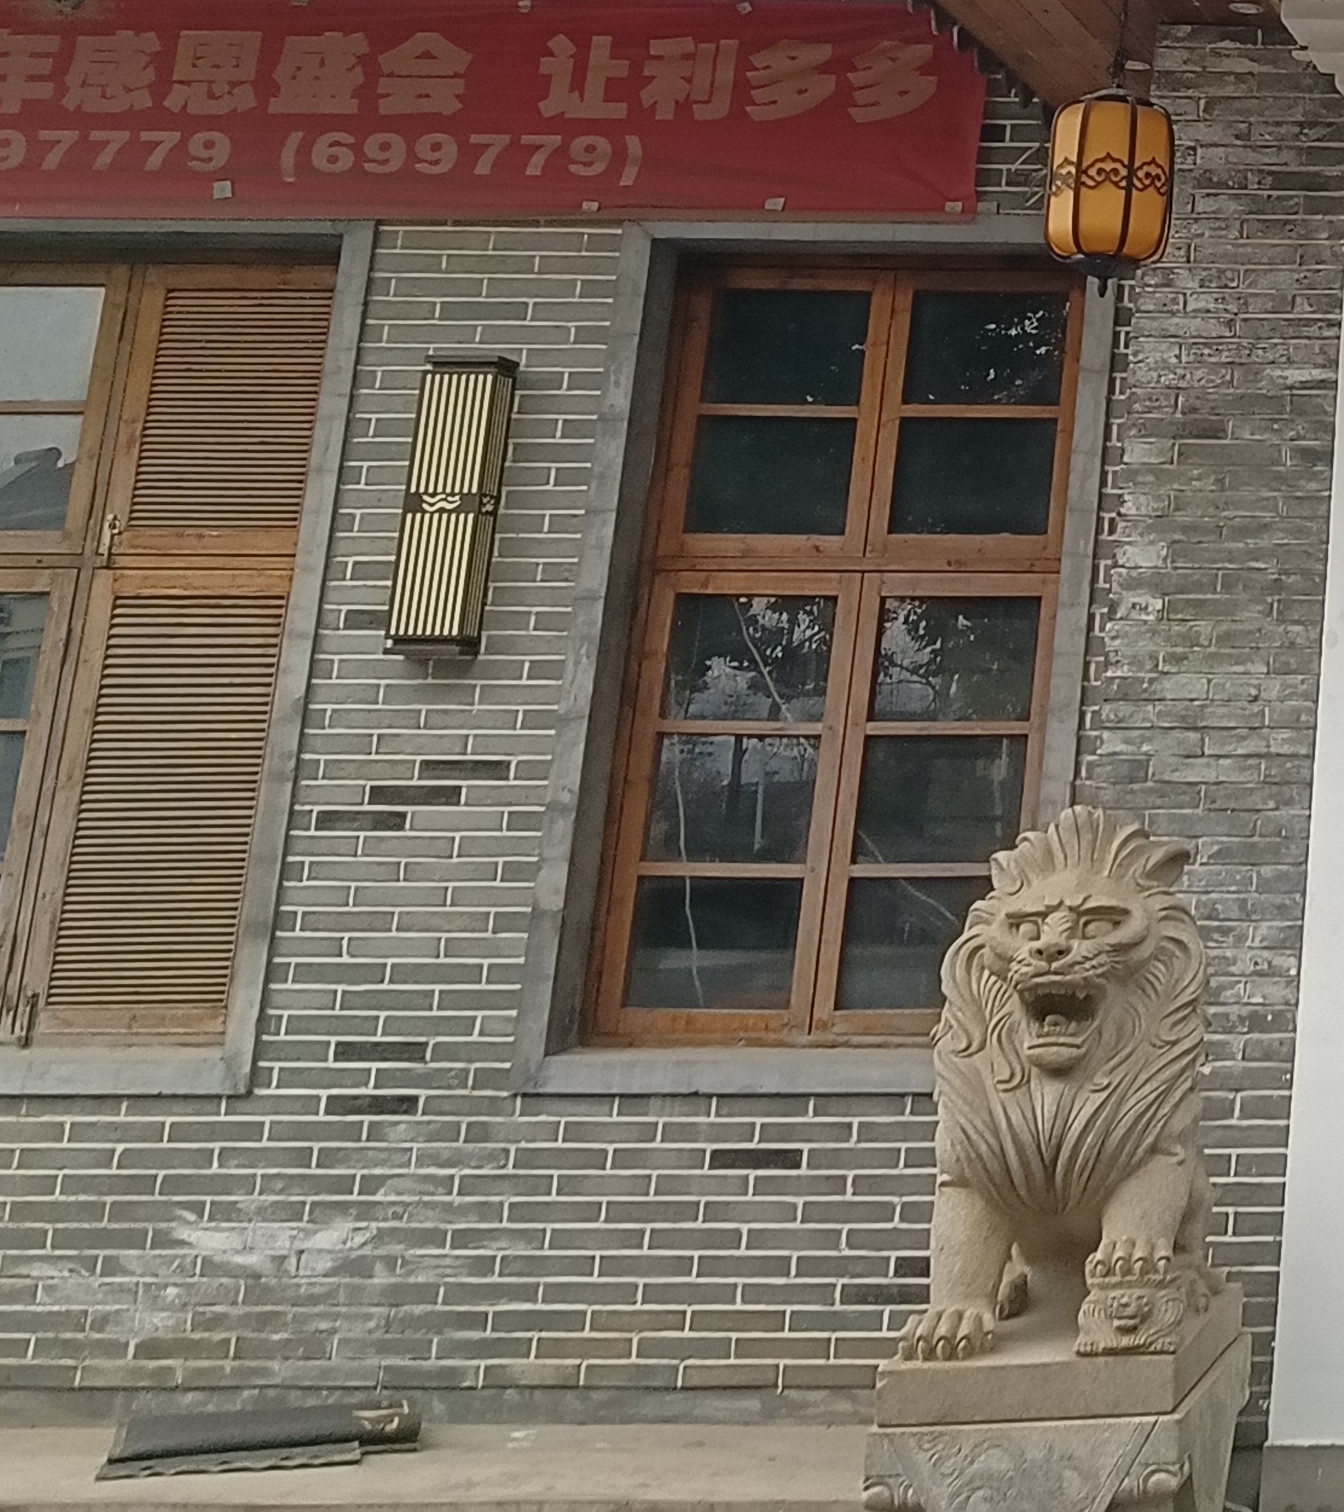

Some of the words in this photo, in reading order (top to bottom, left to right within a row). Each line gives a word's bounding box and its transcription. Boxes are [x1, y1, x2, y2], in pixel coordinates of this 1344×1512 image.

[538, 34, 937, 122] 让利多多
[281, 131, 642, 185] (699779)
